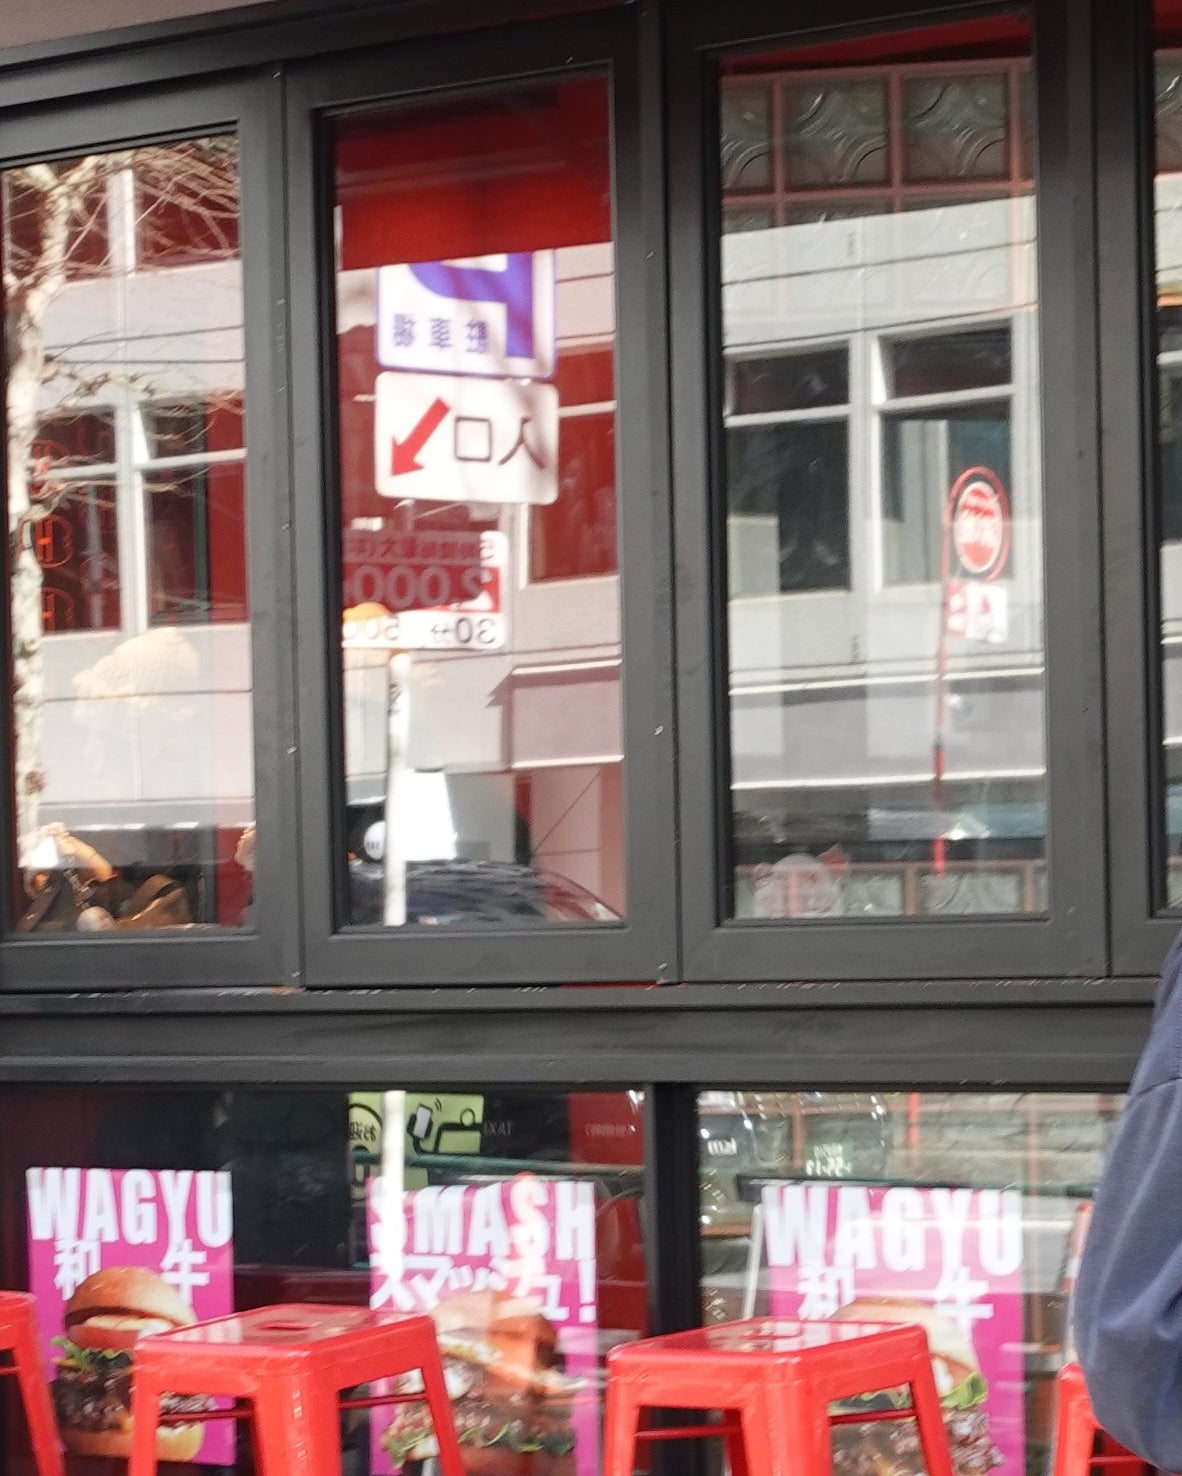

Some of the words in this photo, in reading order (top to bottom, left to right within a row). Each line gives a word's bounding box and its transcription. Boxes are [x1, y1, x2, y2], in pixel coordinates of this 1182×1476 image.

[26, 1166, 233, 1249] WAGYU
[369, 1176, 595, 1262] SMASH
[761, 1185, 1025, 1277] WAGYU
